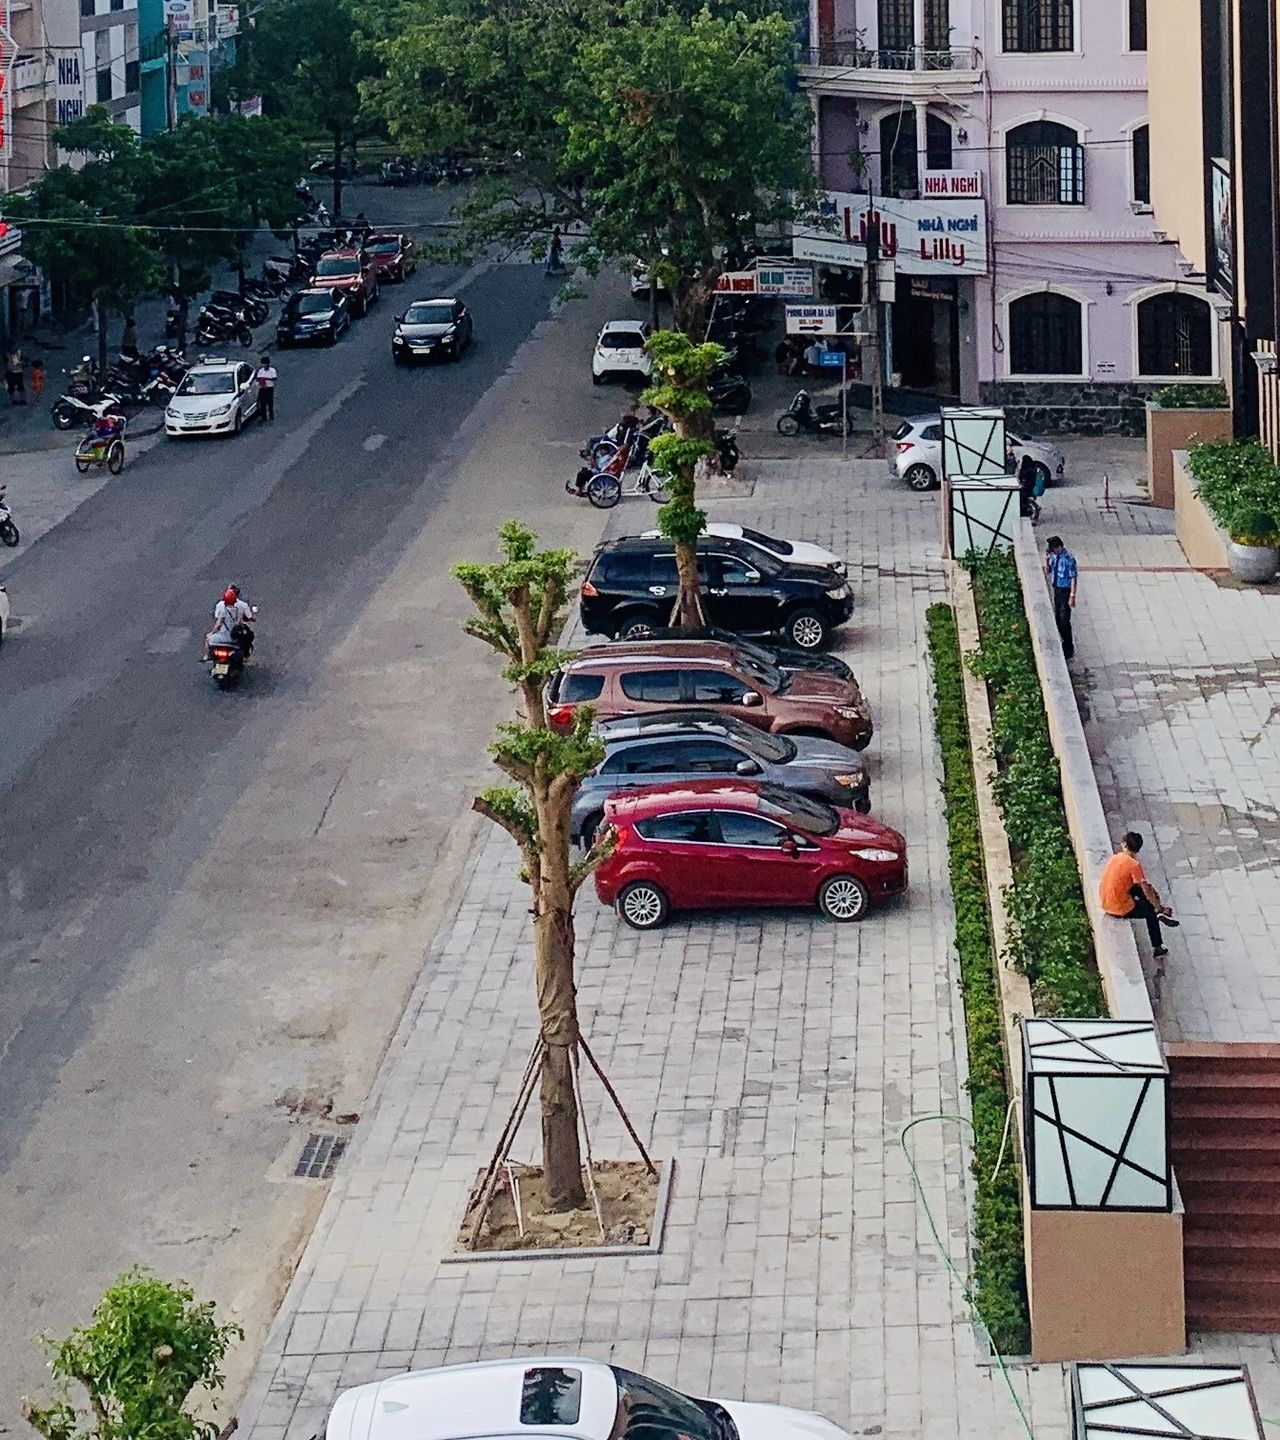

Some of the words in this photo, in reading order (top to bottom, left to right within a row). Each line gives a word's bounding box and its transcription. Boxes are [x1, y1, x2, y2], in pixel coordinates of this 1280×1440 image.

[58, 52, 81, 85] NHÀ
[925, 174, 948, 193] NHÀ
[951, 172, 978, 193] NGHỈ
[918, 216, 944, 232] NHÀ
[948, 214, 978, 232] NGHỈ
[920, 238, 965, 266] Lilly
